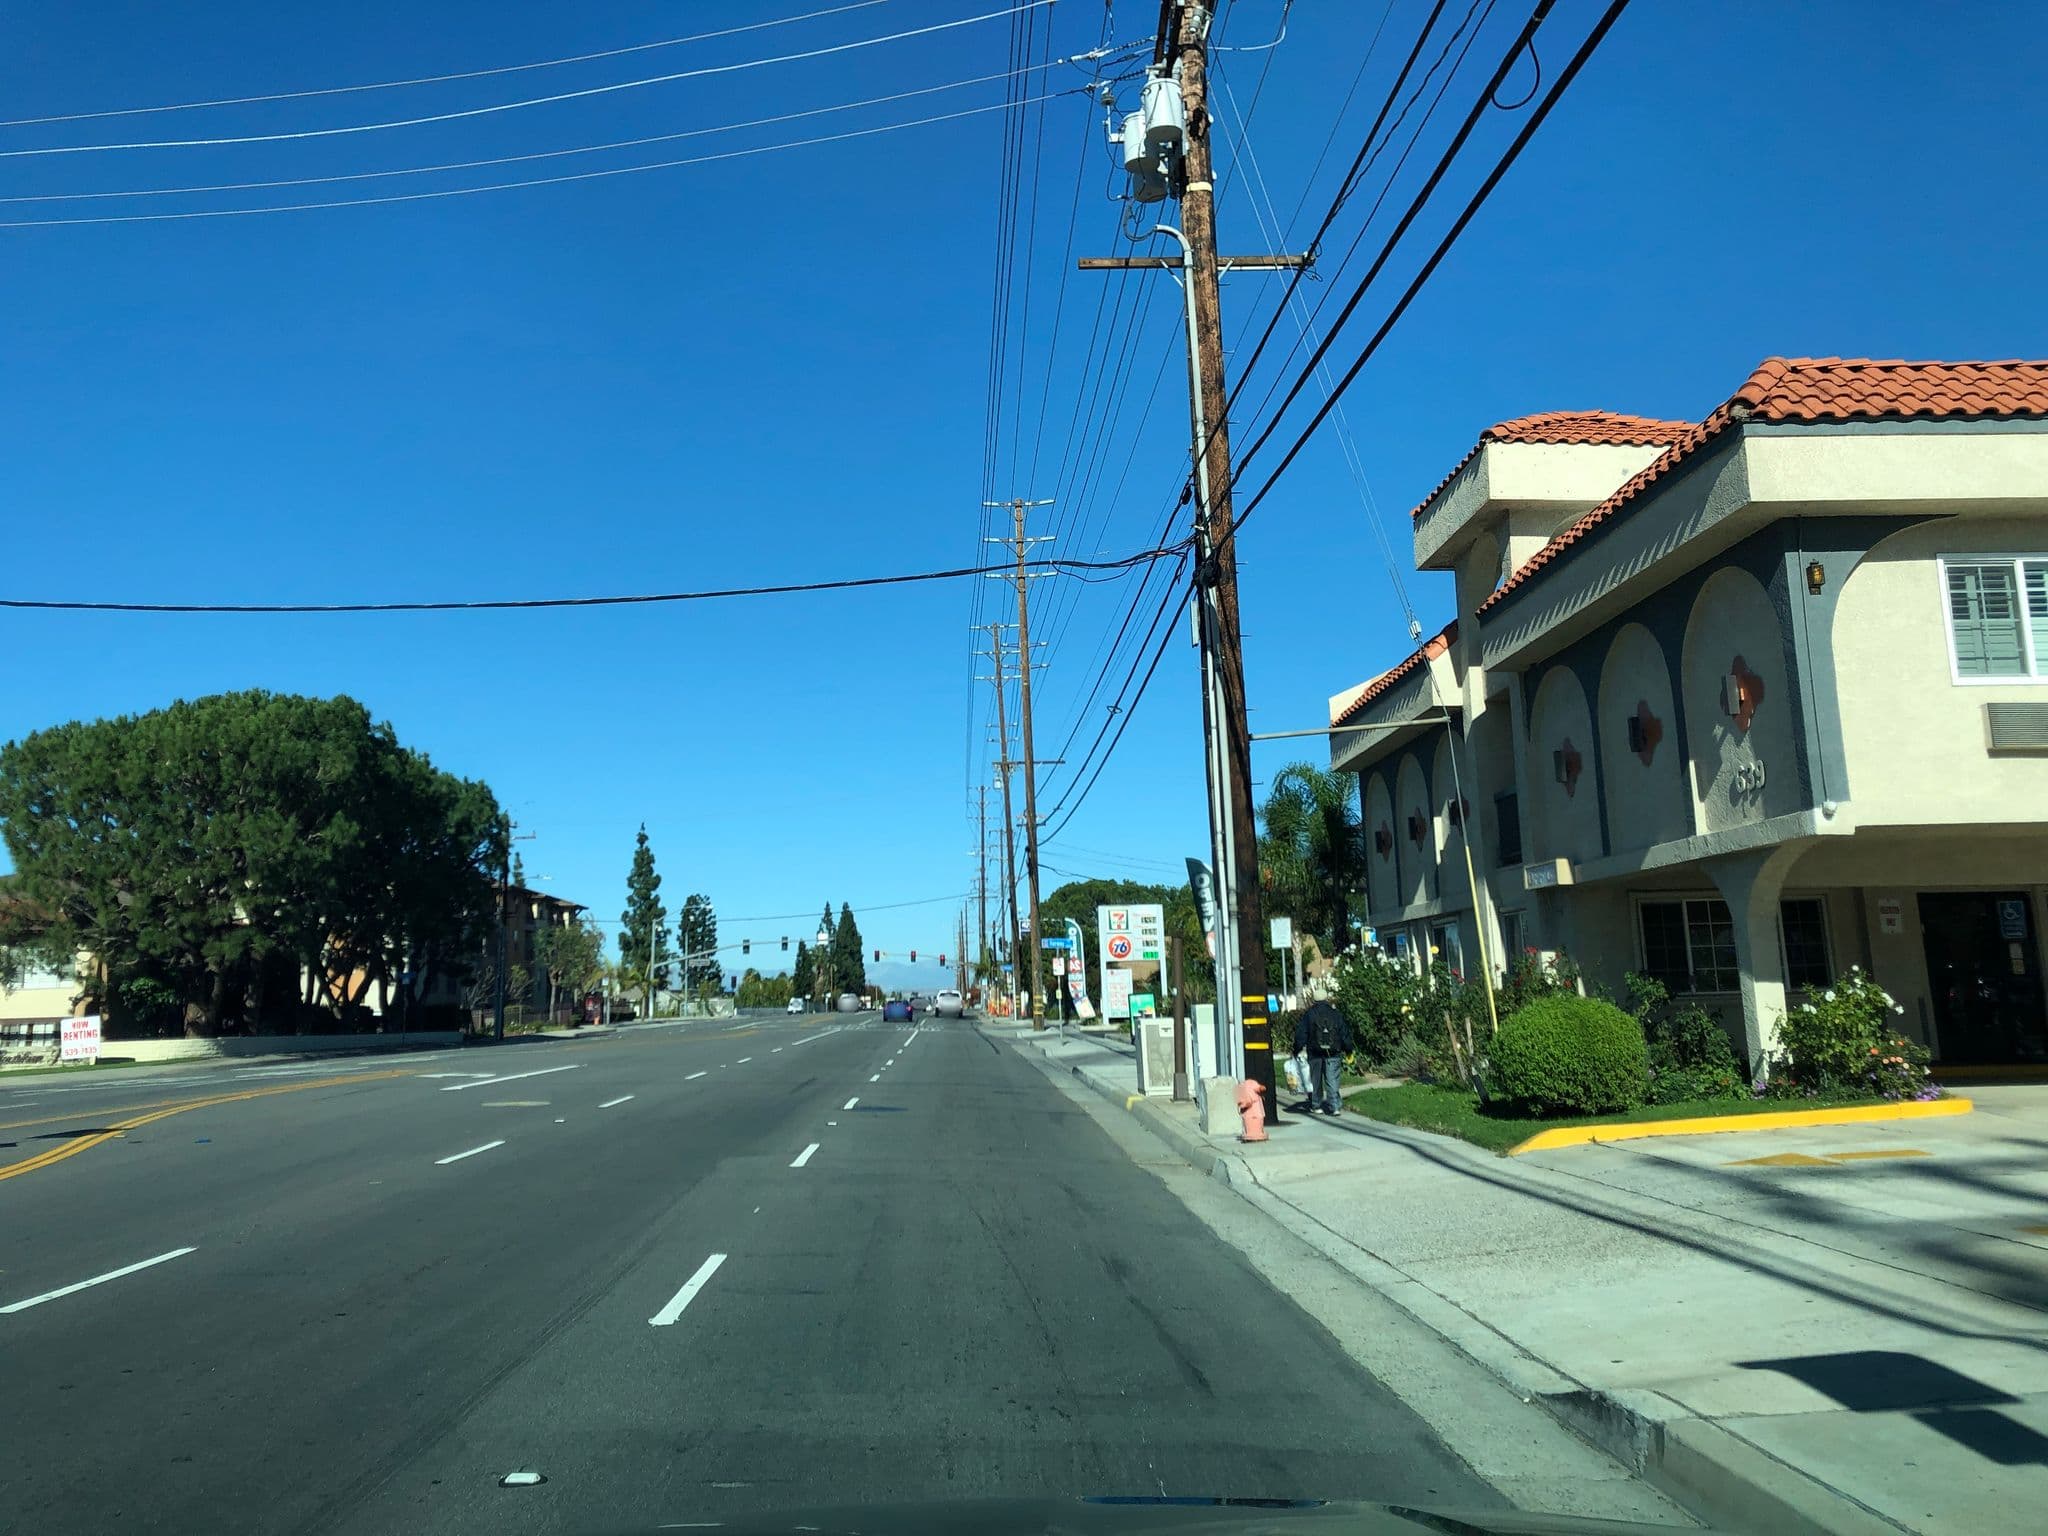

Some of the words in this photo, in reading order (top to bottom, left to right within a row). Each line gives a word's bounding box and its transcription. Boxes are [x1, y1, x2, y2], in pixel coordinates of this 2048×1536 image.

[1735, 760, 1765, 793] 639
[1113, 941, 1128, 954] 76
[63, 1029, 98, 1041] RENTING
